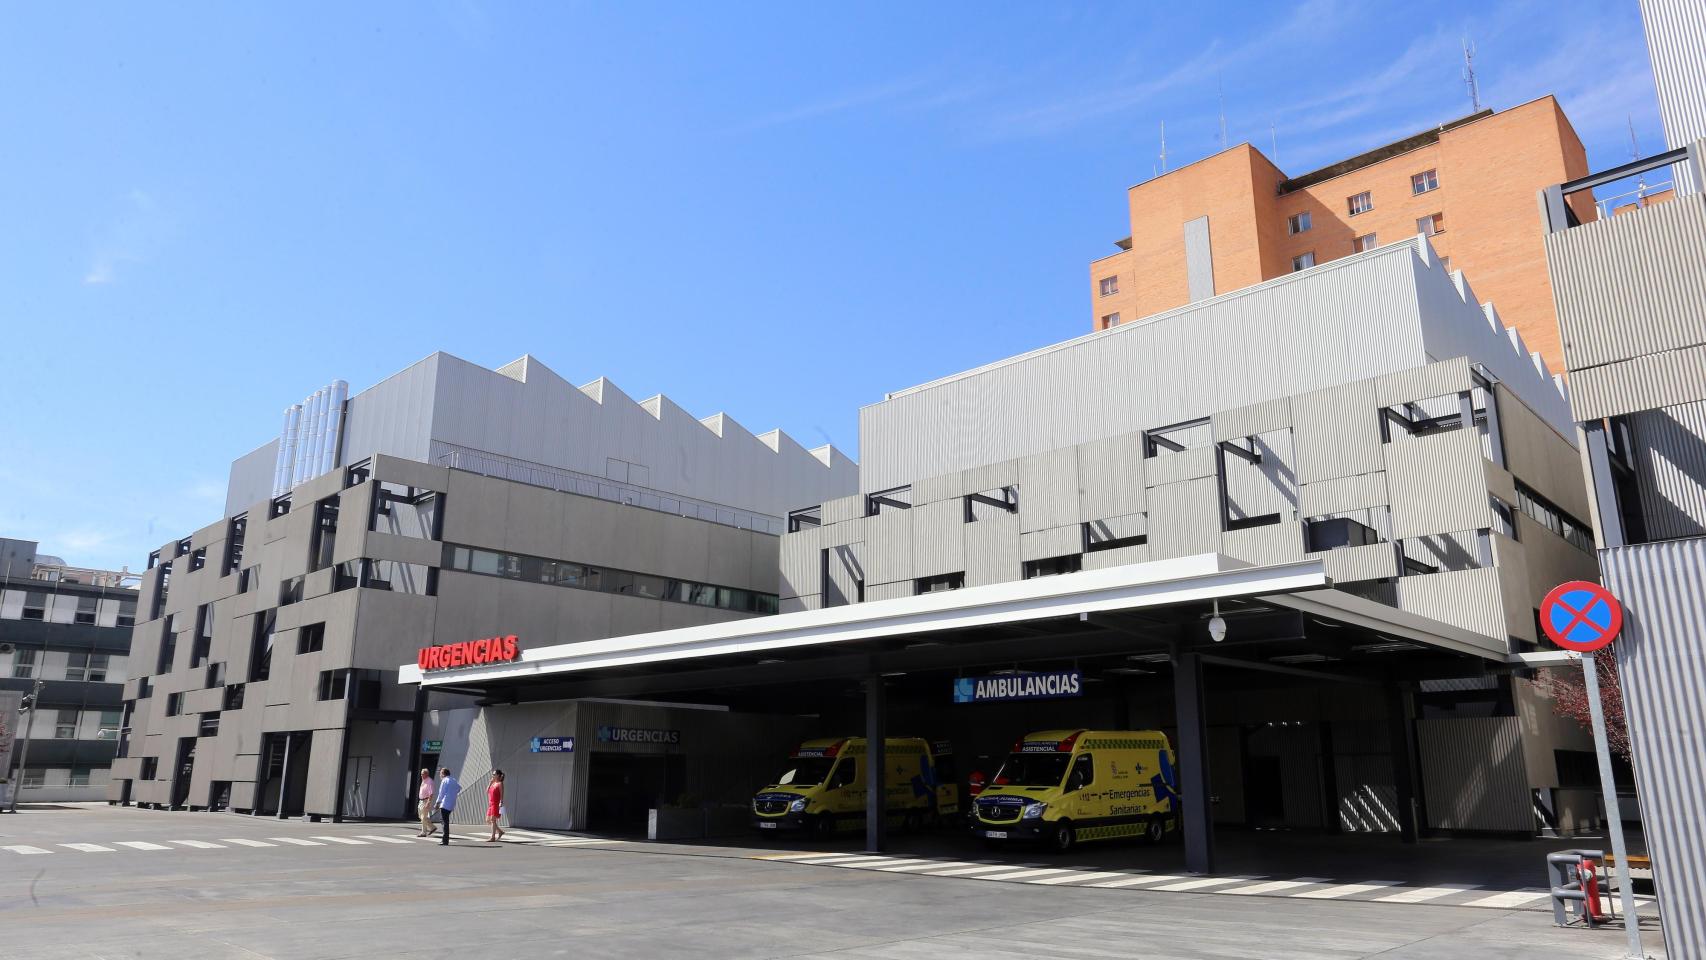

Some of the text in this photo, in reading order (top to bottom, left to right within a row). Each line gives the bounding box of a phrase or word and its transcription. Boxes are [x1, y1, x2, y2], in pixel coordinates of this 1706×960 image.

[418, 634, 518, 670] URGENCIAS
[975, 673, 1079, 699] AMBULANCIAS
[612, 728, 679, 744] URGENCIAS
[1109, 789, 1150, 801] Emergencias
[1110, 804, 1141, 815] Sanitarias
